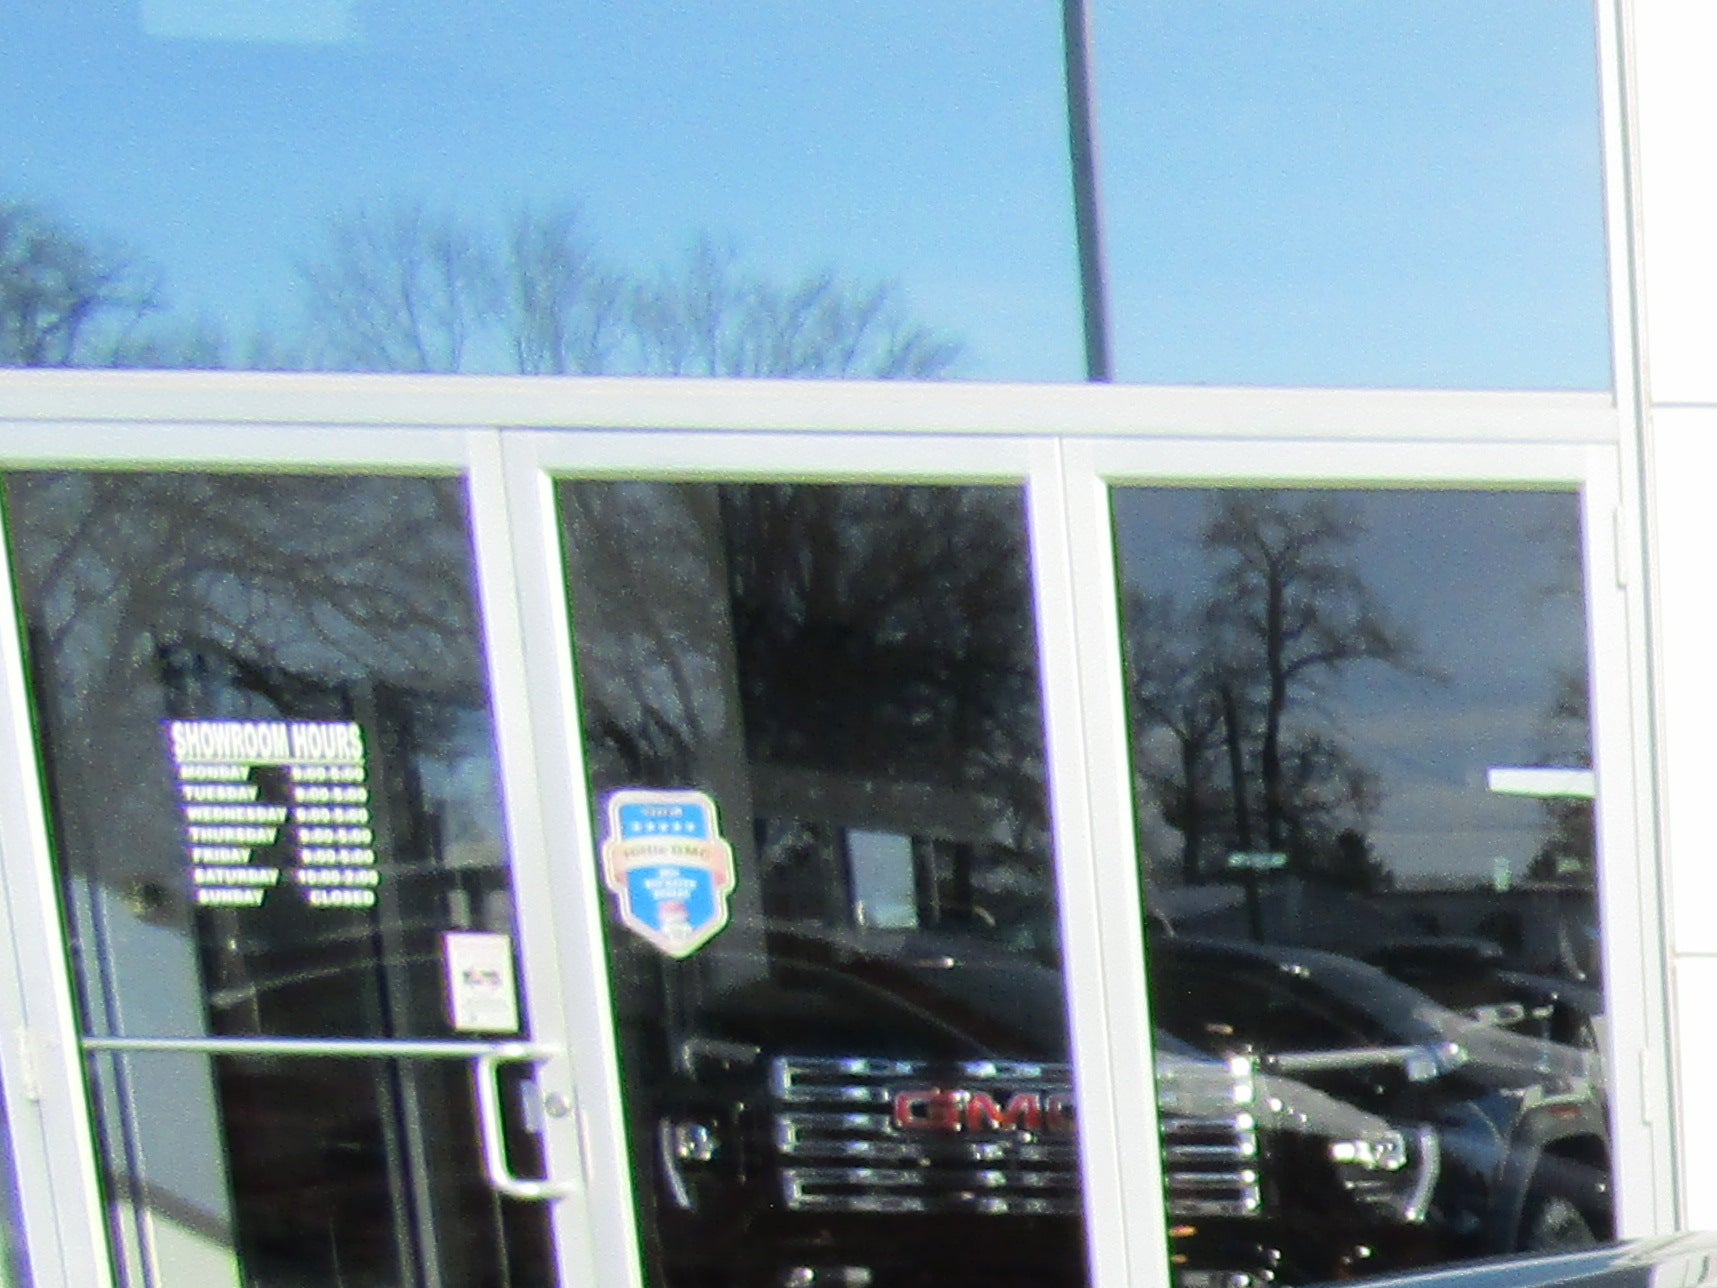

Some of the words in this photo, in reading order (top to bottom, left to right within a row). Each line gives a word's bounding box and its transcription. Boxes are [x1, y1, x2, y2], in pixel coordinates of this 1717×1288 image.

[171, 721, 290, 760] SHOWROOM
[290, 722, 364, 761] HOURS
[180, 766, 249, 781] MONDAY
[183, 785, 258, 801] TUESDAY
[187, 806, 287, 823] WEDNESDAY
[188, 826, 277, 843] THURSDAY
[192, 847, 251, 864] FRIDAY
[194, 867, 280, 885] SATURDAY
[198, 888, 264, 906] SUNDAY
[309, 889, 376, 907] CLOSED
